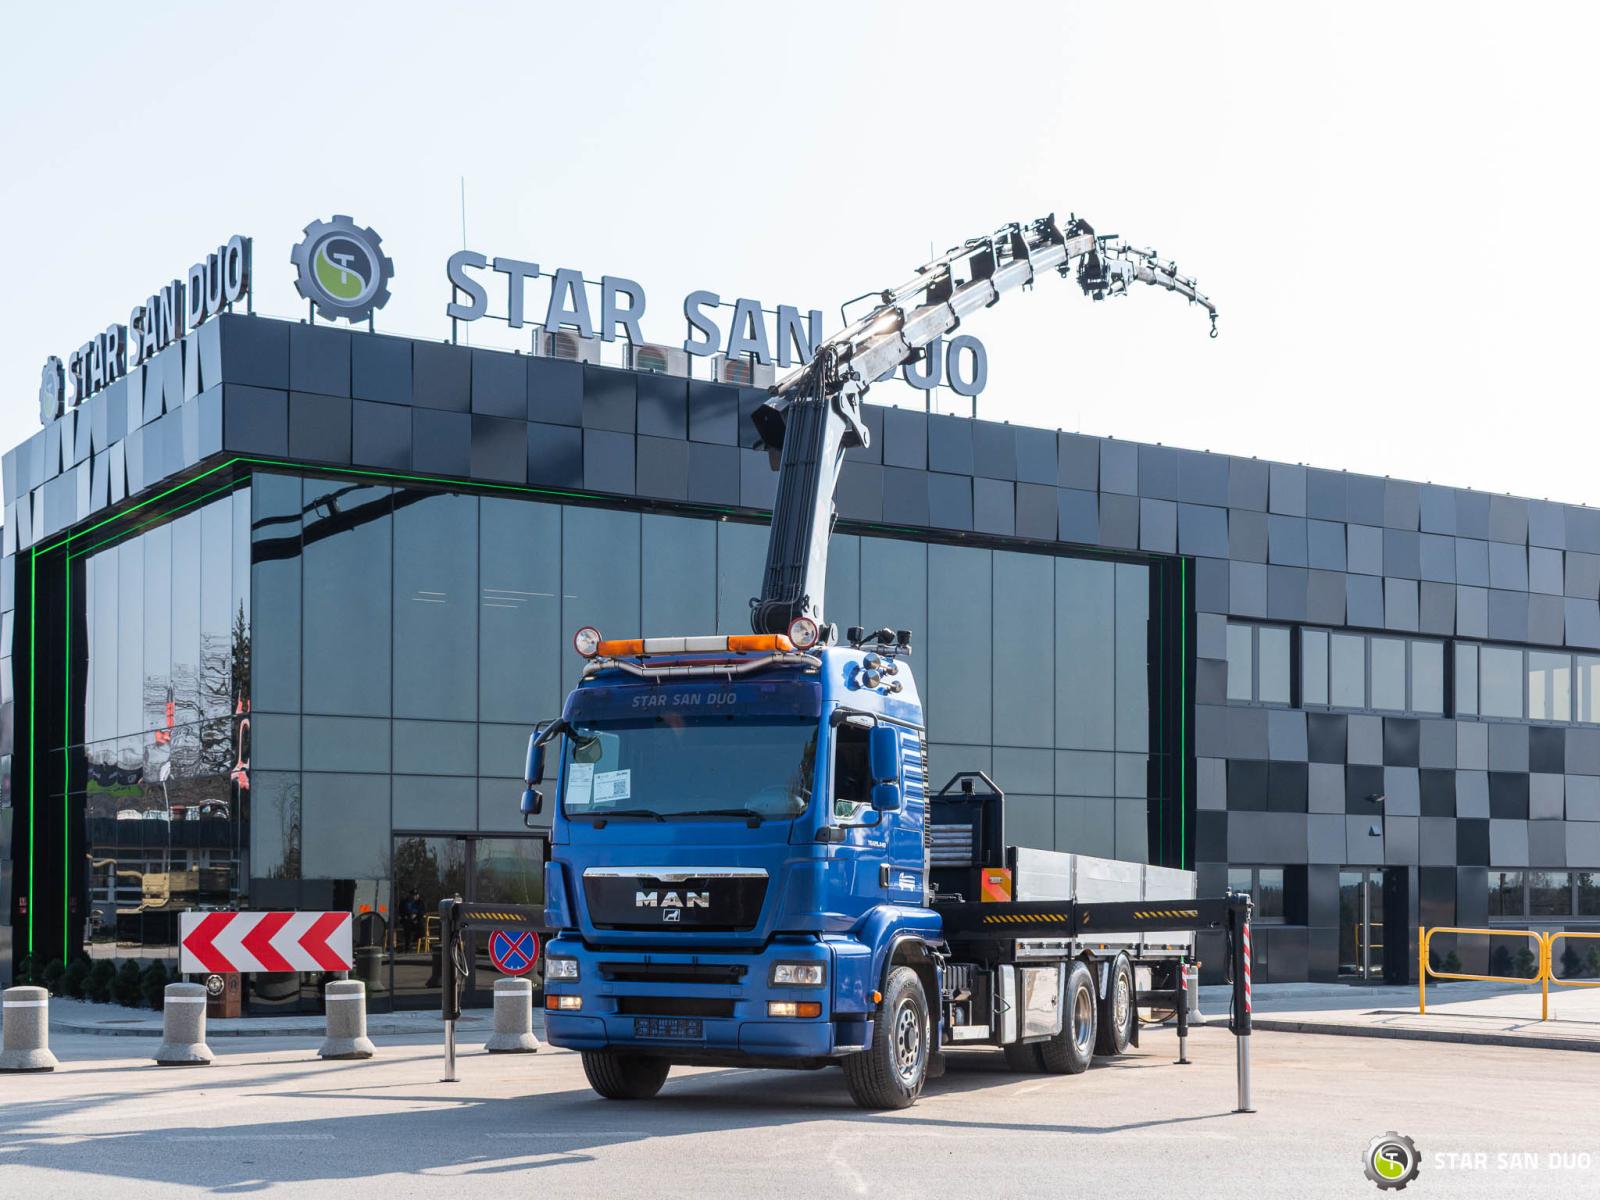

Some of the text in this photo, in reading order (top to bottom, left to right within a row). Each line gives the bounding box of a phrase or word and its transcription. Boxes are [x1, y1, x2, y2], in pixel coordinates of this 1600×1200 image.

[68, 234, 249, 407] STAR SAN DUO
[446, 249, 988, 397] STAR SAN UO
[632, 692, 737, 708] STAR SAN DUO
[635, 891, 710, 908] MAN
